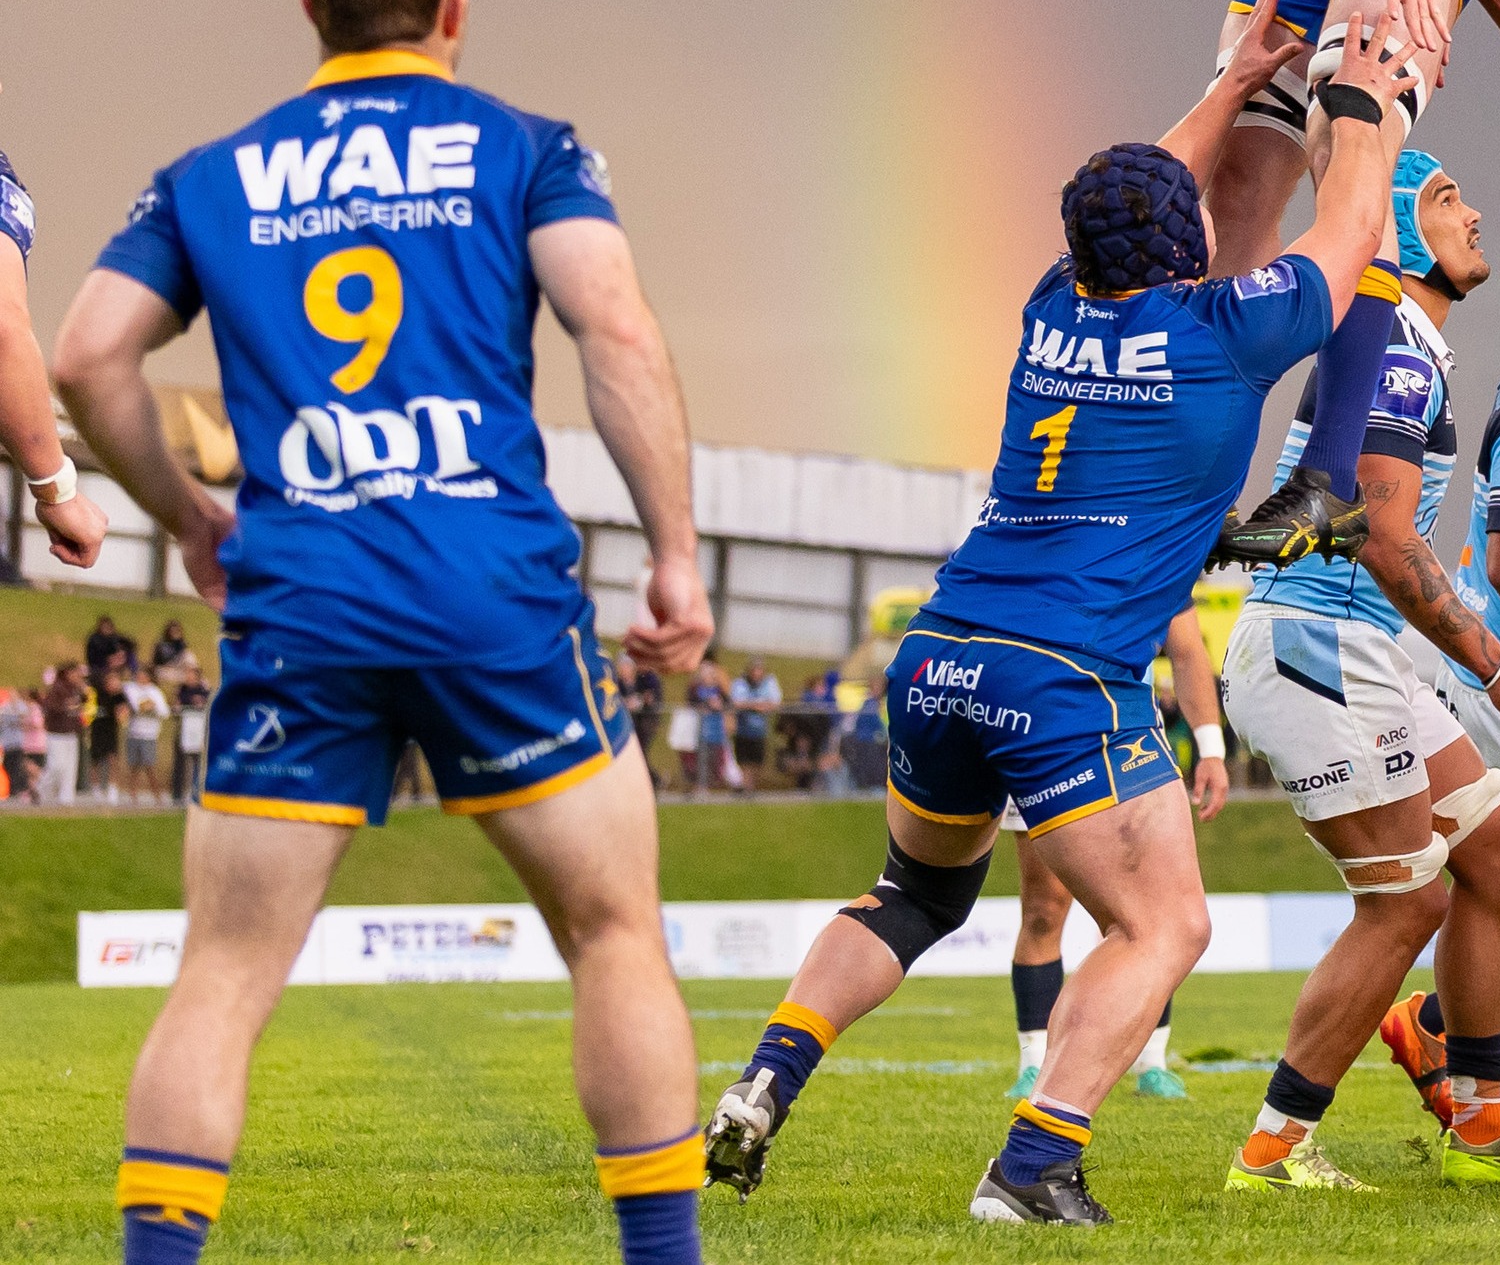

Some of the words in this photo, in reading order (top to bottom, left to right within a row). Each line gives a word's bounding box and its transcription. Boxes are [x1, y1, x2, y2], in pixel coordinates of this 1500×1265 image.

[233, 121, 481, 212] WAE
[250, 195, 473, 246] ENGINEERING
[303, 245, 403, 395] 9
[1087, 306, 1115, 321] Spark
[1025, 318, 1174, 380] WAE
[1021, 370, 1174, 402] ENGINEERING
[278, 394, 482, 491] ODT
[1030, 404, 1078, 493] 1
[911, 657, 984, 691] Allied
[906, 686, 1032, 735] Petroleum
[1376, 726, 1409, 748] ARC
[1121, 751, 1160, 773] GILBERT
[1282, 767, 1351, 794] AIRZONE
[1024, 768, 1096, 807] SOUTHBASE
